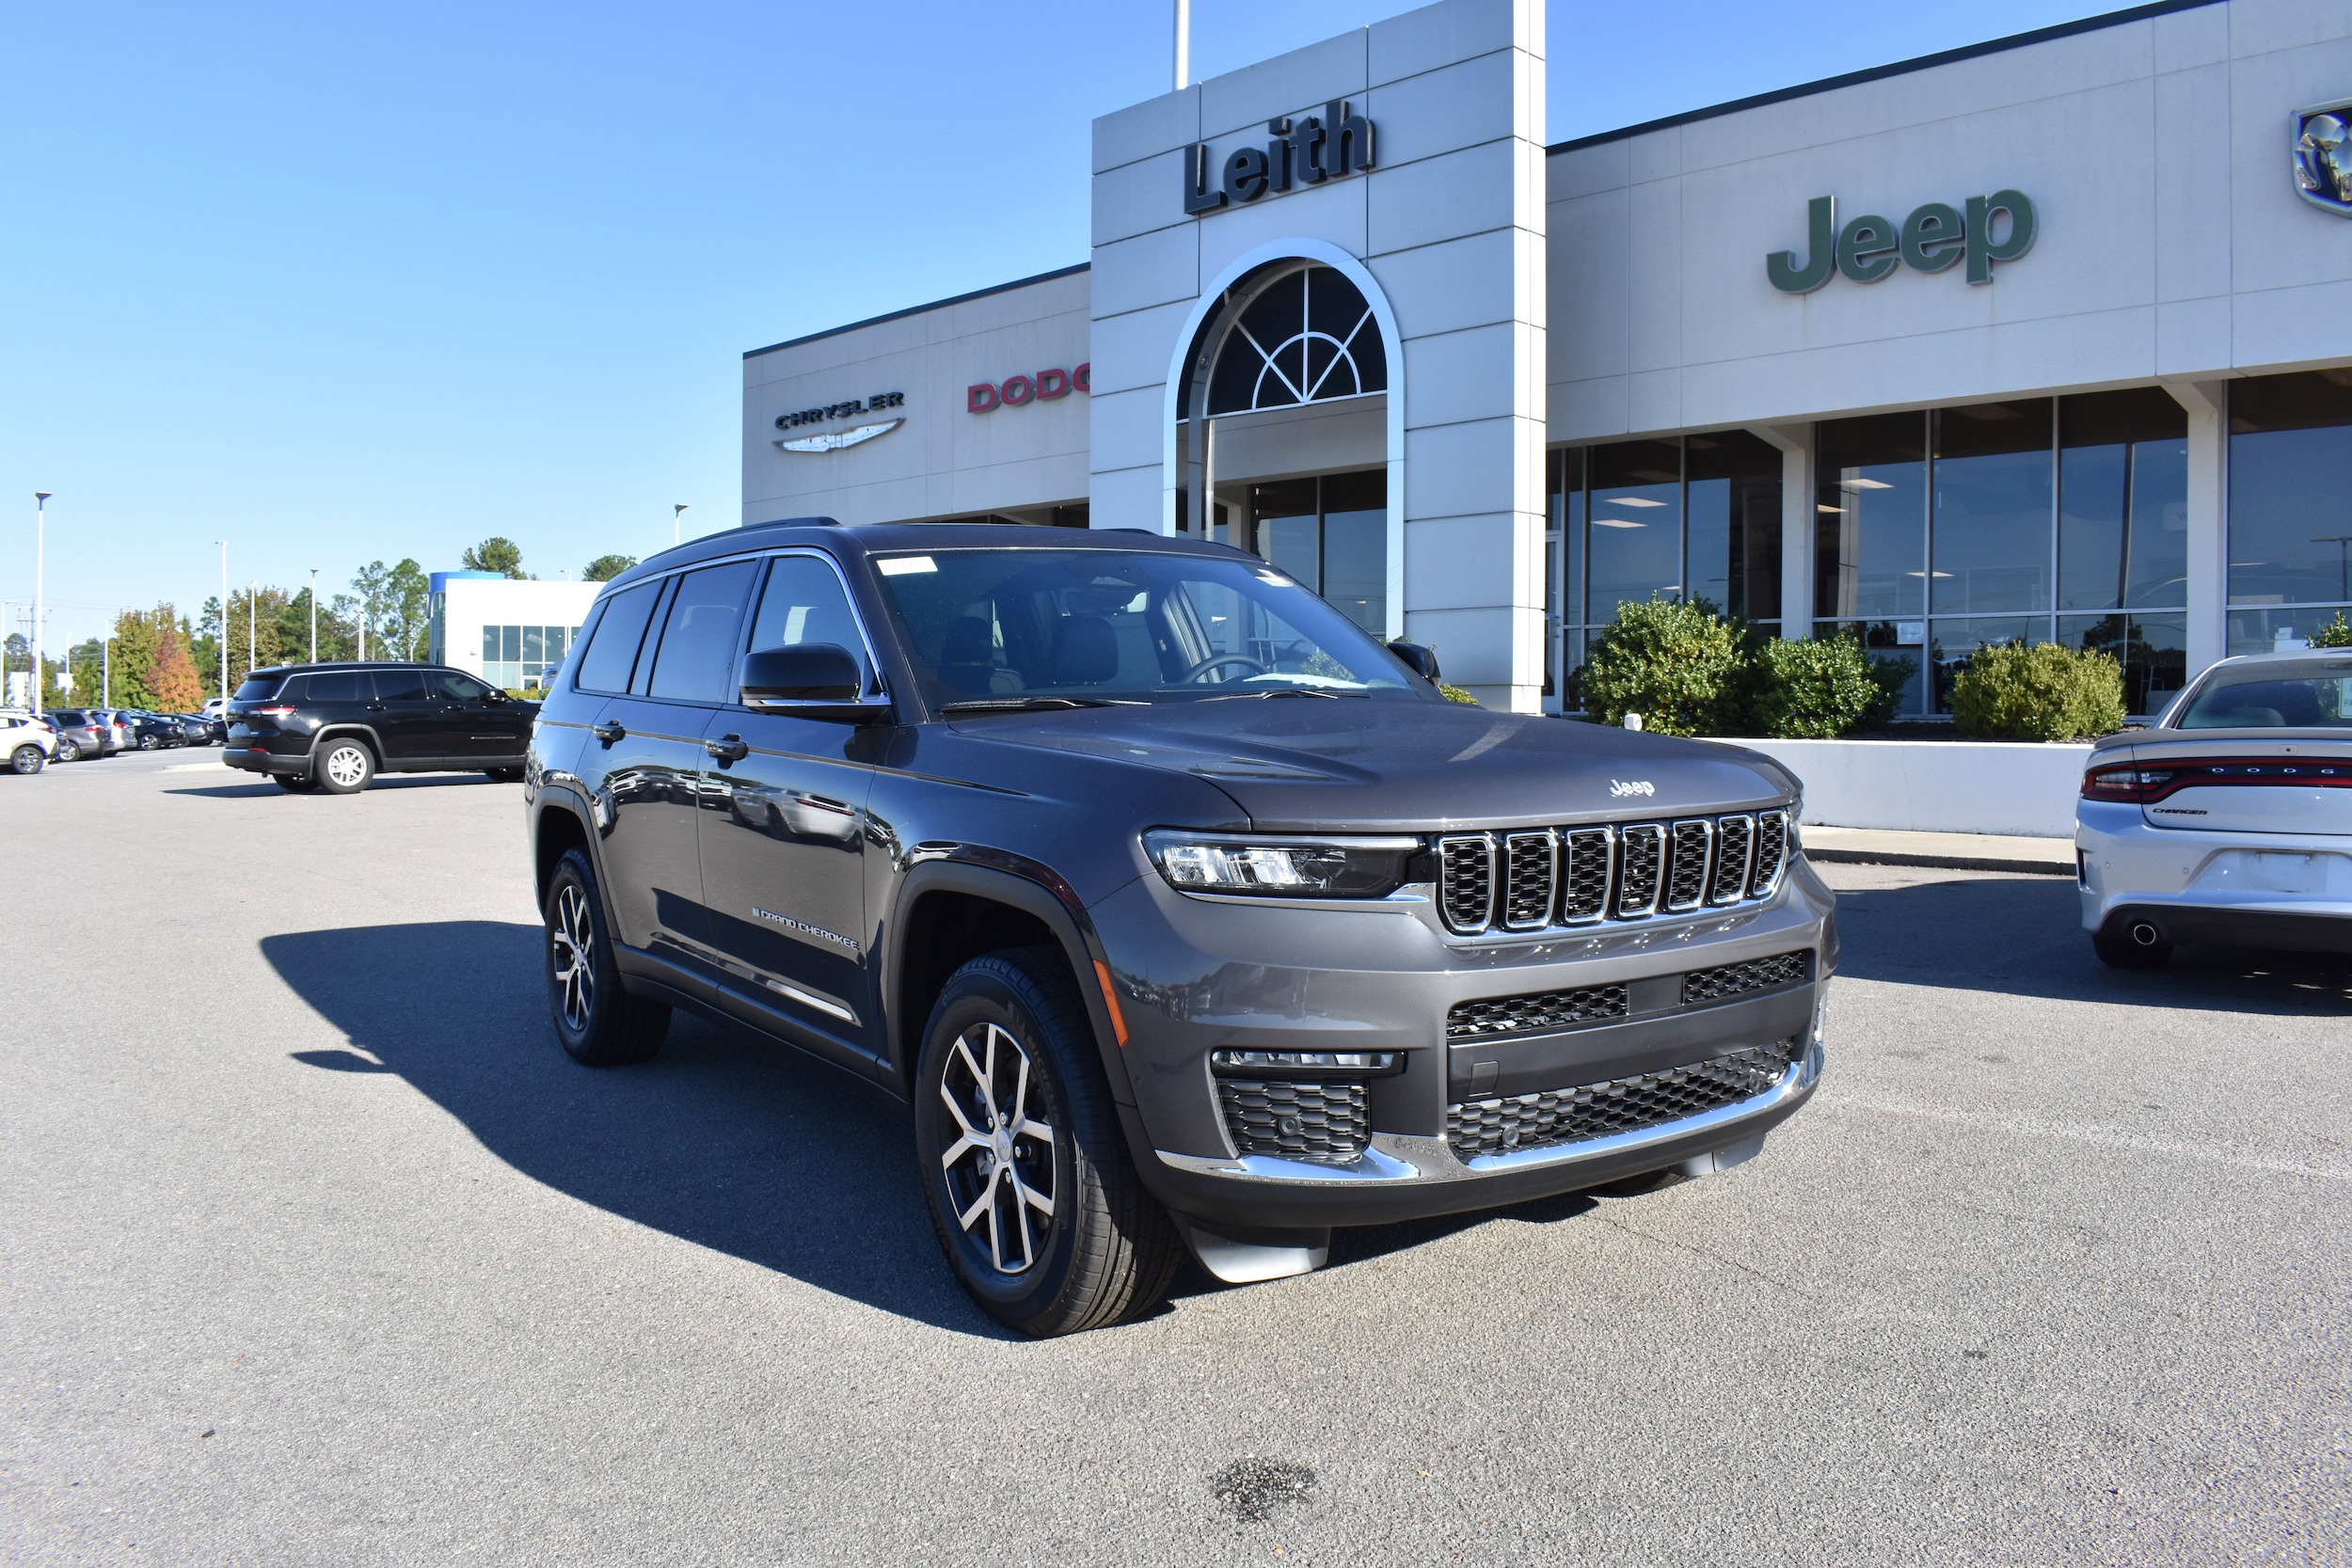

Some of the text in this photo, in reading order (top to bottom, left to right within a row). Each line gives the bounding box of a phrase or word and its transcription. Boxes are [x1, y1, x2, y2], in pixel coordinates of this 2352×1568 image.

[1184, 99, 1376, 216] Leith
[1767, 188, 2040, 294] Jeep
[775, 391, 905, 430] CHRYSLER
[967, 362, 1090, 414] DODG
[1608, 779, 1656, 798] Jeep
[761, 911, 859, 951] GRAND CHEROKEE
[1025, 1035, 1062, 1128] MICHELIN
